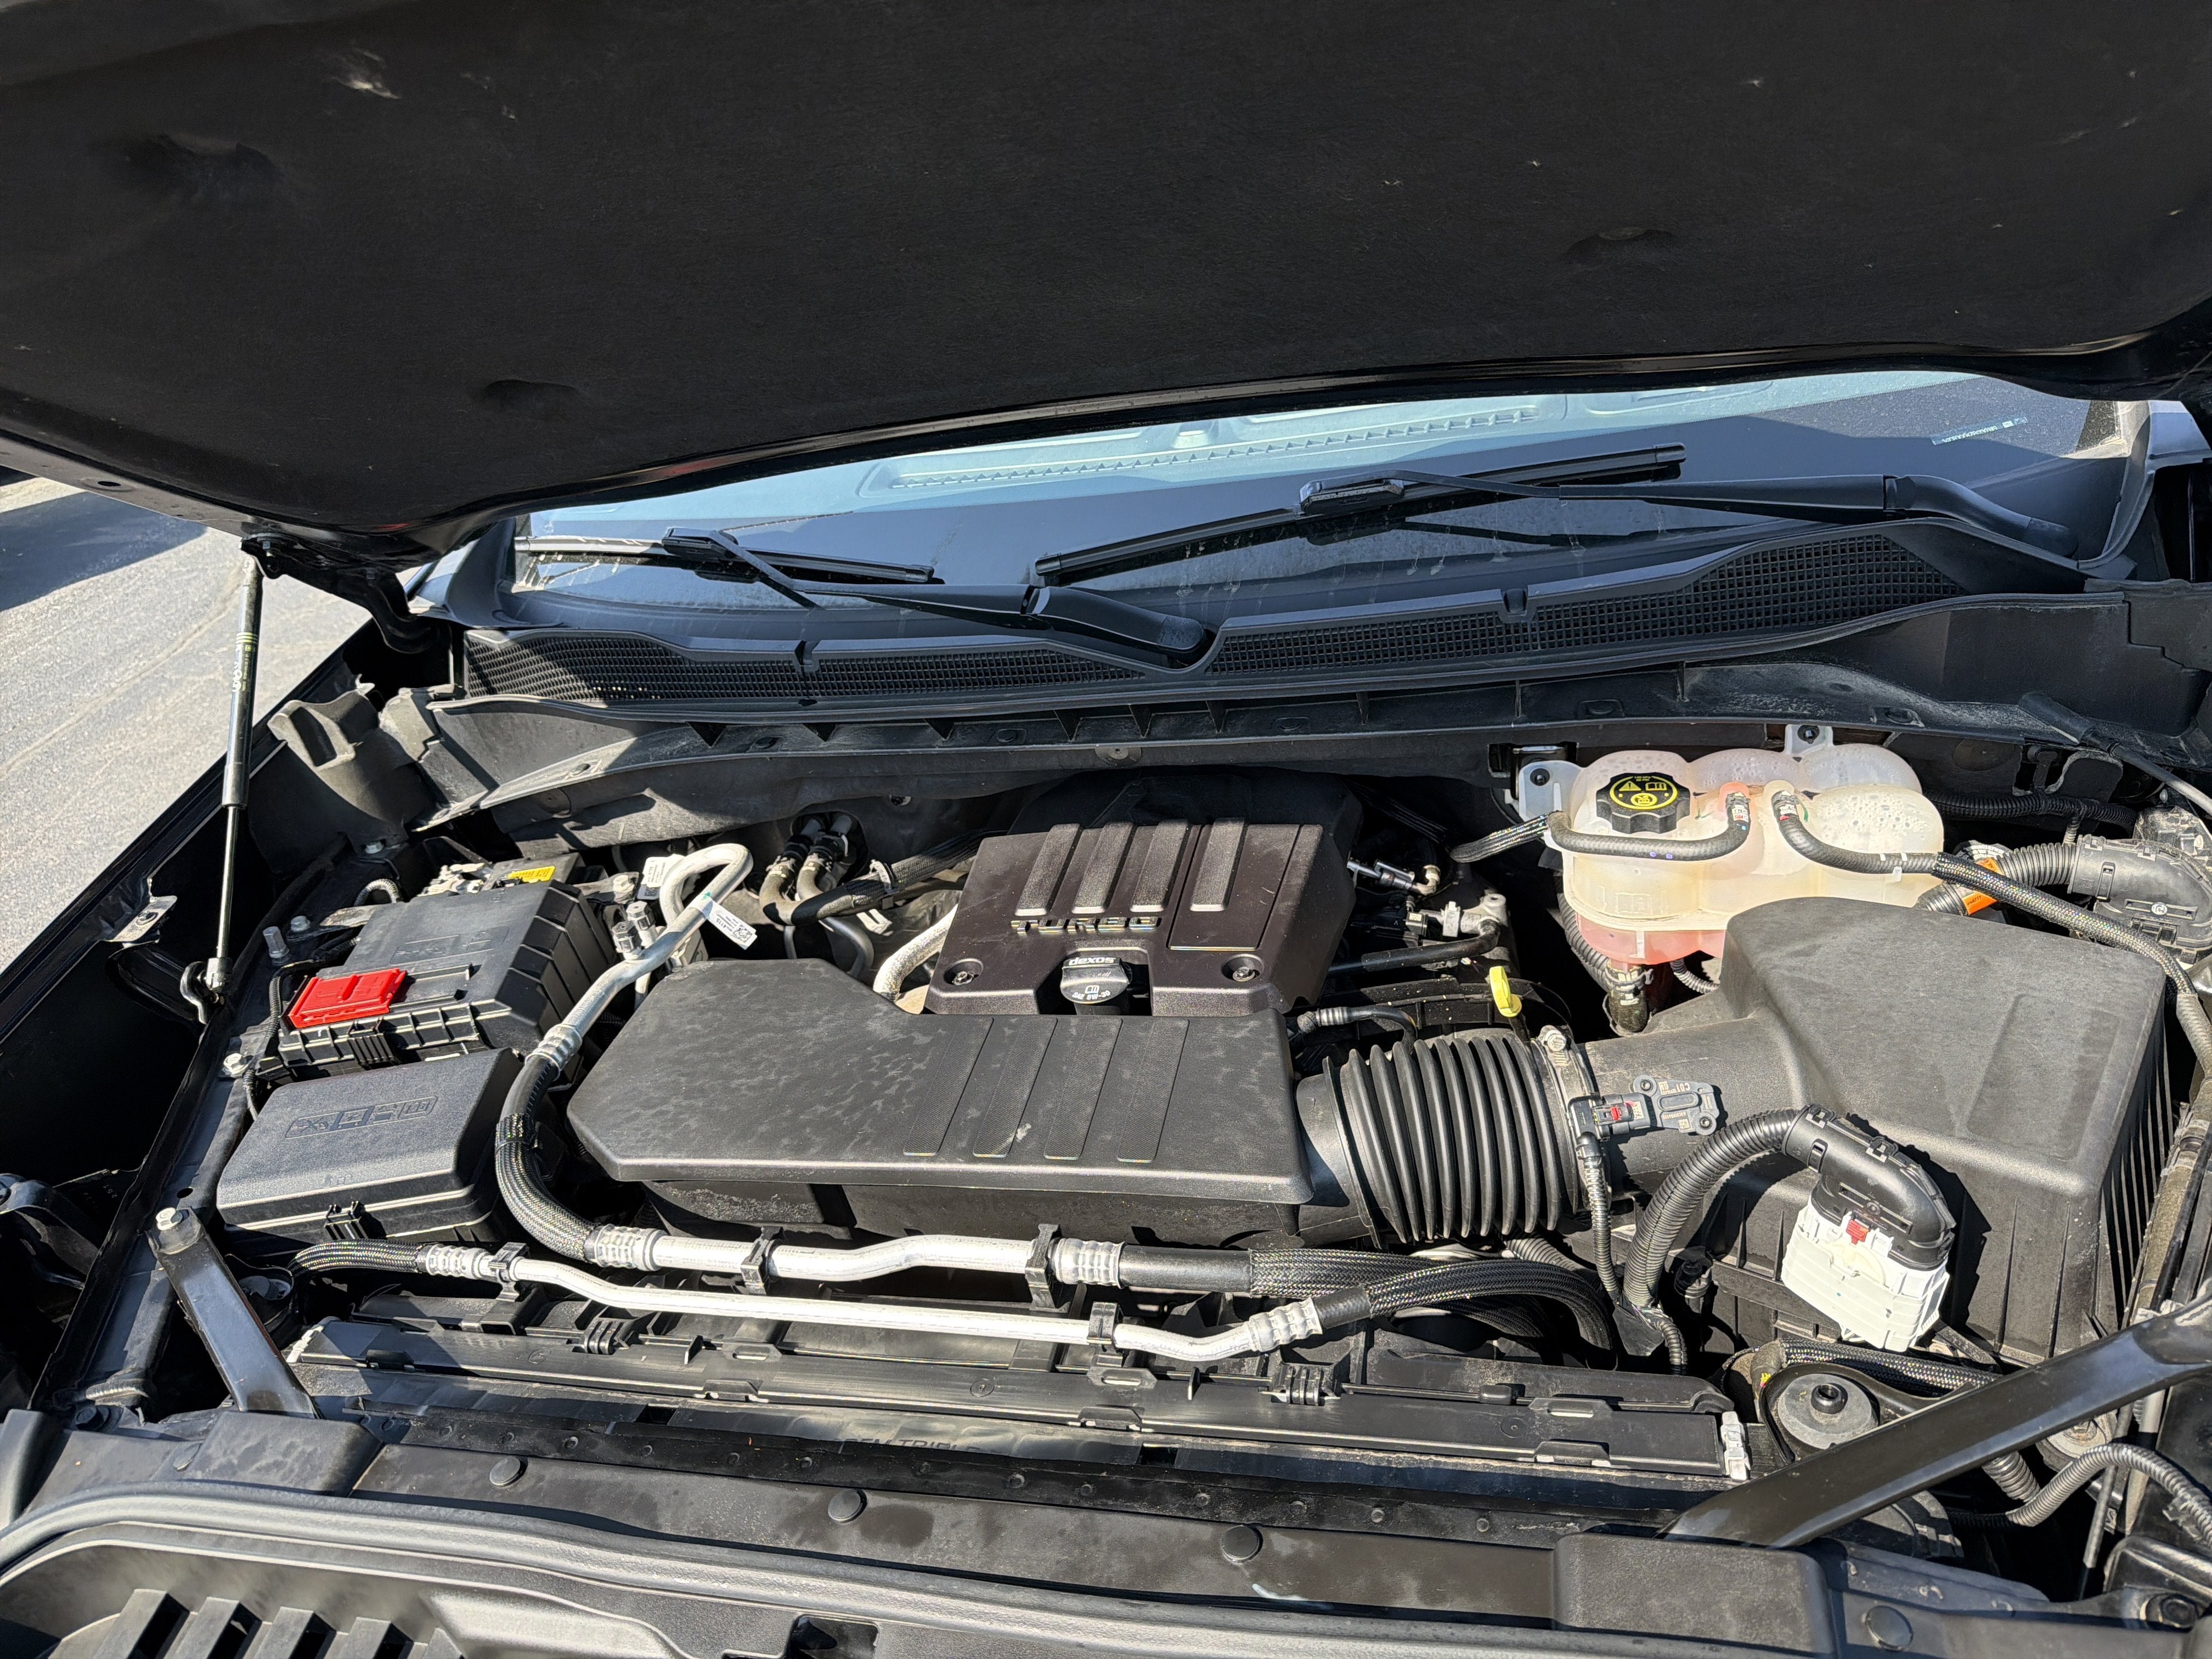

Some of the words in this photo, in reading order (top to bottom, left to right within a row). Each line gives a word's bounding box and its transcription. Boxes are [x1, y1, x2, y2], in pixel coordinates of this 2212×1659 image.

[1011, 916, 1159, 934] TURBO
[1068, 957, 1116, 966] dexos
[1086, 990, 1111, 1000] 5W-30
